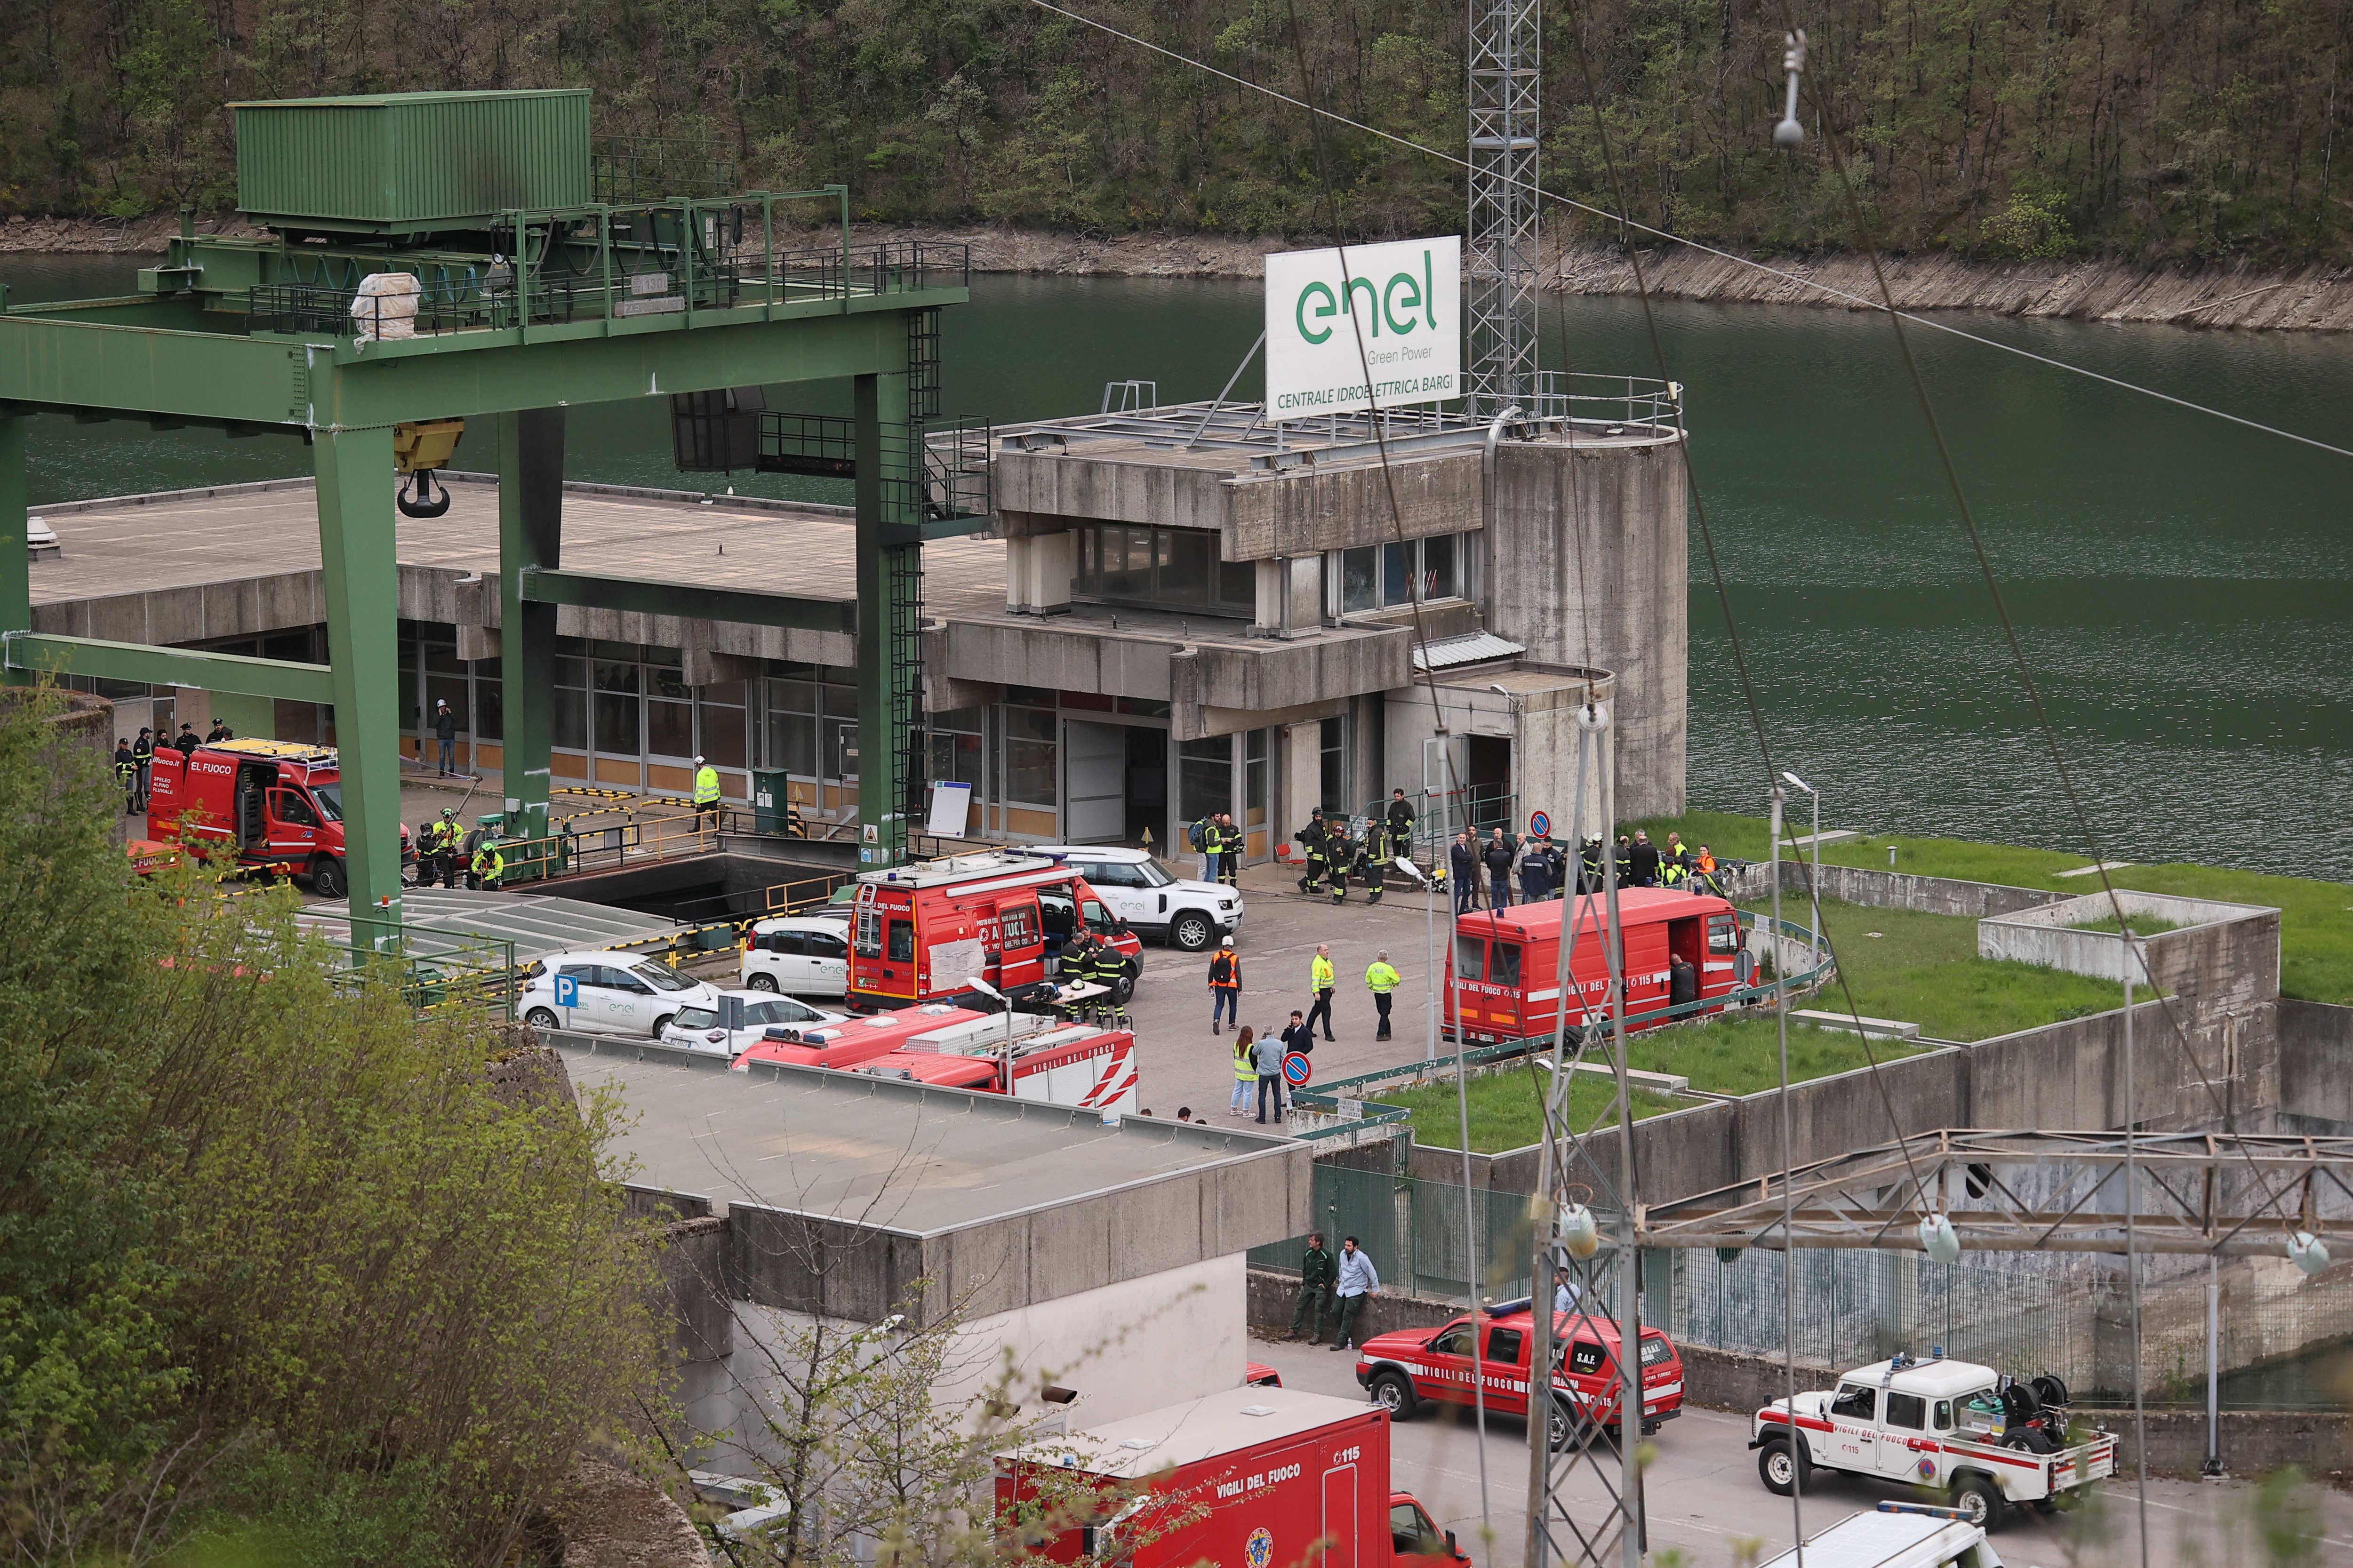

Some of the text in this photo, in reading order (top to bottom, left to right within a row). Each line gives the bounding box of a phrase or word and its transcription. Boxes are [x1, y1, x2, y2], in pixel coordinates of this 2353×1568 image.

[1297, 250, 1437, 344] enel
[1368, 346, 1433, 365] Green Power
[1278, 374, 1453, 408] CENTRALE IDROELETTRICA BARGI
[191, 761, 232, 775] EL FUOCO
[889, 904, 910, 912] FUOCO
[1120, 900, 1145, 910] enel
[1009, 913, 1025, 921] AVANATO
[820, 964, 845, 975] enel
[1450, 980, 1466, 990] VILI
[1468, 984, 1479, 992] DEL
[1481, 985, 1501, 996] FUOCO
[1590, 981, 1604, 992] DEL
[1639, 975, 1650, 986] 115
[559, 978, 573, 1003] P
[609, 1003, 634, 1013] enel
[1032, 1043, 1115, 1073] VIGILI DEL FUOCO
[1577, 1352, 1595, 1365] S.A.F.
[1424, 1366, 1512, 1390] VIGILI DEL FUOCO
[1835, 1426, 1907, 1445] VIGILI DEL FUOCO
[1342, 1445, 1361, 1463] 115
[1849, 1445, 1859, 1455] 115
[1217, 1463, 1300, 1499] VIGILI DEL FUOCO
